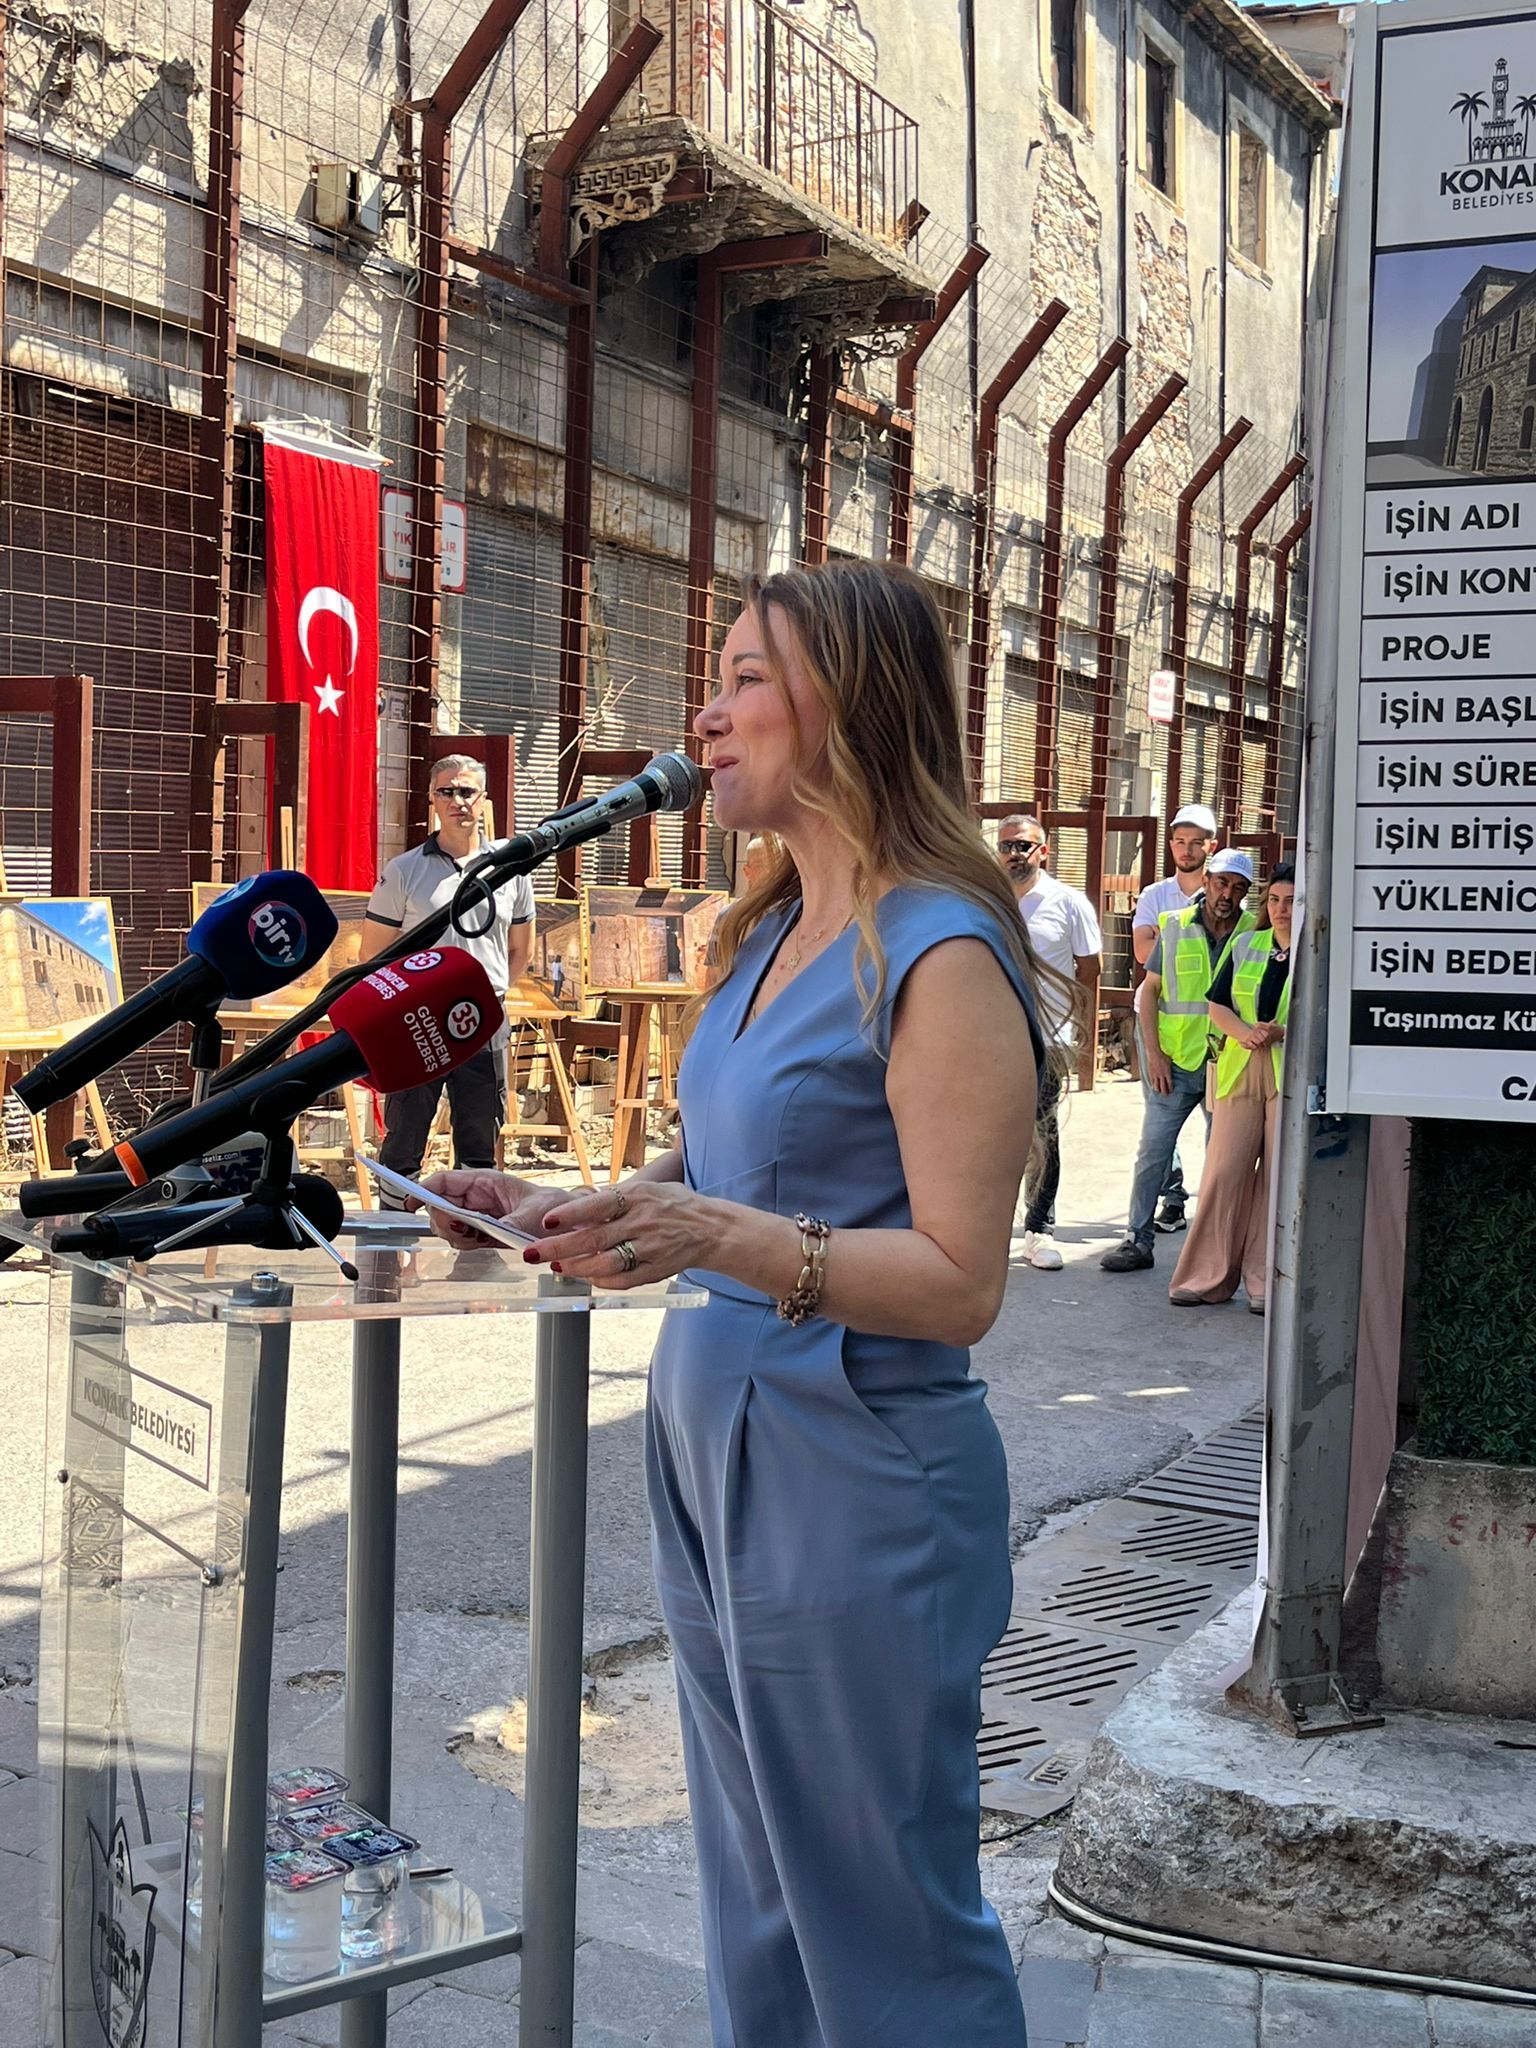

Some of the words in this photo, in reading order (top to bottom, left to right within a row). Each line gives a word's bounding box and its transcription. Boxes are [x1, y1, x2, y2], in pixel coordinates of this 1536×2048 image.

[1440, 163, 1536, 196] KONA
[1452, 191, 1536, 211] BELEDİYES
[1386, 500, 1450, 539] İŞİN
[1460, 503, 1520, 531] ADI
[1384, 564, 1448, 603] İŞİN
[1382, 634, 1491, 662] PROJE
[1380, 691, 1444, 730] İŞİN
[1456, 696, 1536, 728] BAŞL
[1378, 755, 1442, 793] İŞİN
[1453, 754, 1536, 787] SÜRE
[1376, 817, 1439, 855] İŞİN
[1451, 816, 1534, 855] BİTİŞ
[1372, 879, 1536, 912] YÜKLENİC
[251, 903, 290, 947] bir
[1370, 941, 1435, 979] İŞİN
[1446, 949, 1536, 976] BEDE
[417, 1005, 452, 1066] GÜNDEM
[451, 1003, 478, 1036] 35
[1369, 1007, 1496, 1033] Taşınmaz
[1503, 1010, 1536, 1032] Kü
[404, 1012, 438, 1073] OTUZBEŞ
[84, 1377, 129, 1420] KONAK
[130, 1402, 196, 1457] BELEDİYESİ
